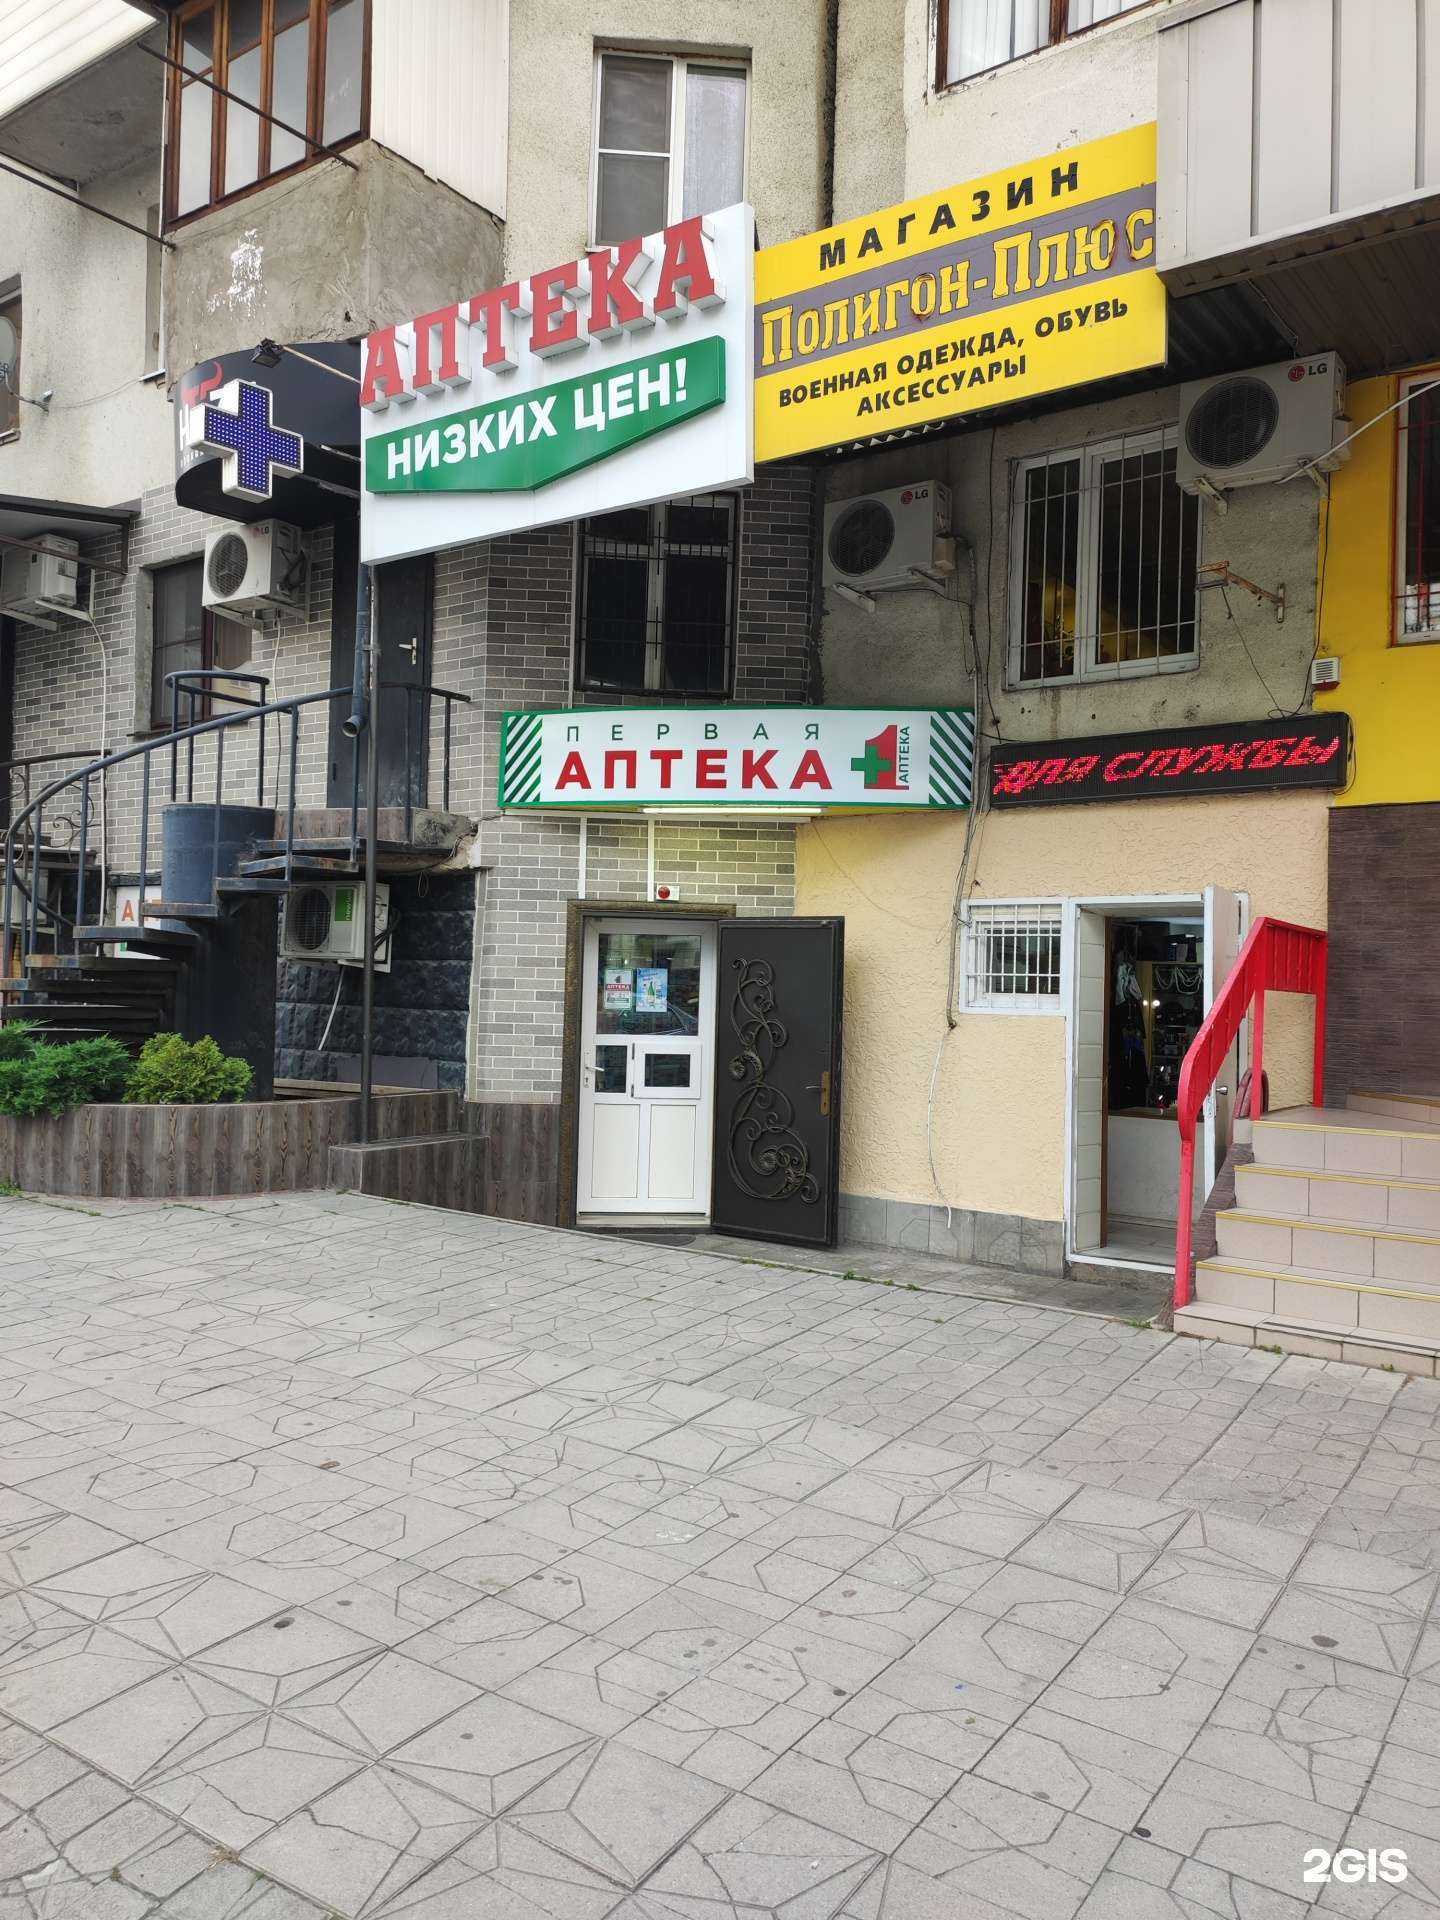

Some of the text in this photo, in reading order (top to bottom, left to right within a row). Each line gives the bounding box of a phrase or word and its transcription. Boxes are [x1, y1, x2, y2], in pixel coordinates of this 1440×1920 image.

[820, 162, 1079, 271] МАГАЗИН
[360, 215, 717, 408] АПТЕКА
[778, 297, 1129, 408] ВОЕННАЯ ОДЕЖДА, ОБУВЬ
[1309, 363, 1328, 376] LG
[856, 355, 1027, 417] АКСЕССУАРЫ
[387, 357, 687, 480] НИЗКИХ ЦЕН!
[914, 489, 929, 499] LG
[566, 723, 820, 742] ПЕРВАЯ
[899, 726, 910, 784] АПТЕКА
[1103, 736, 1340, 781] СЛУЖБЫ
[554, 749, 833, 790] АПТЕКА
